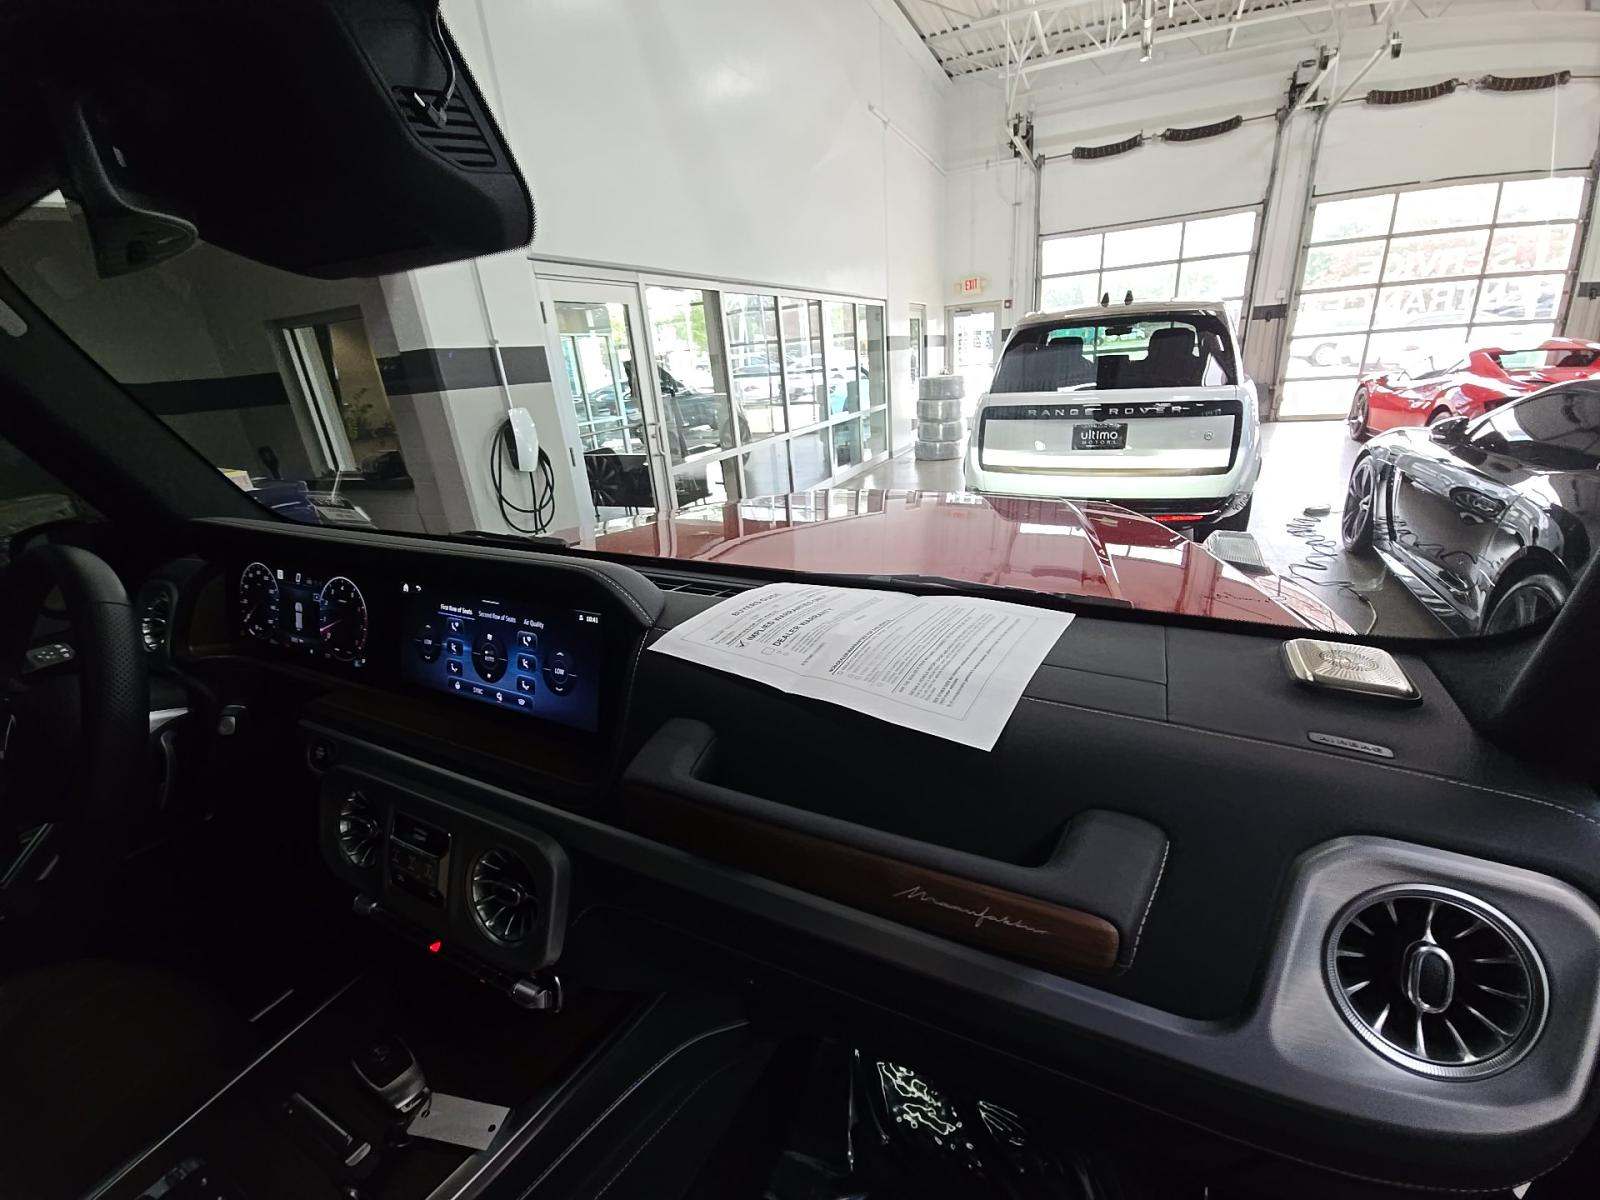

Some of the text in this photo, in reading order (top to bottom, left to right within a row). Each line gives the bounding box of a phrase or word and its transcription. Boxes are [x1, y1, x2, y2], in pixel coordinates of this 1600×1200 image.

[964, 278, 977, 290] EXIT
[1028, 404, 1183, 417] RANGE ROVER
[1081, 429, 1118, 440] ultimo
[529, 620, 545, 630] Quality
